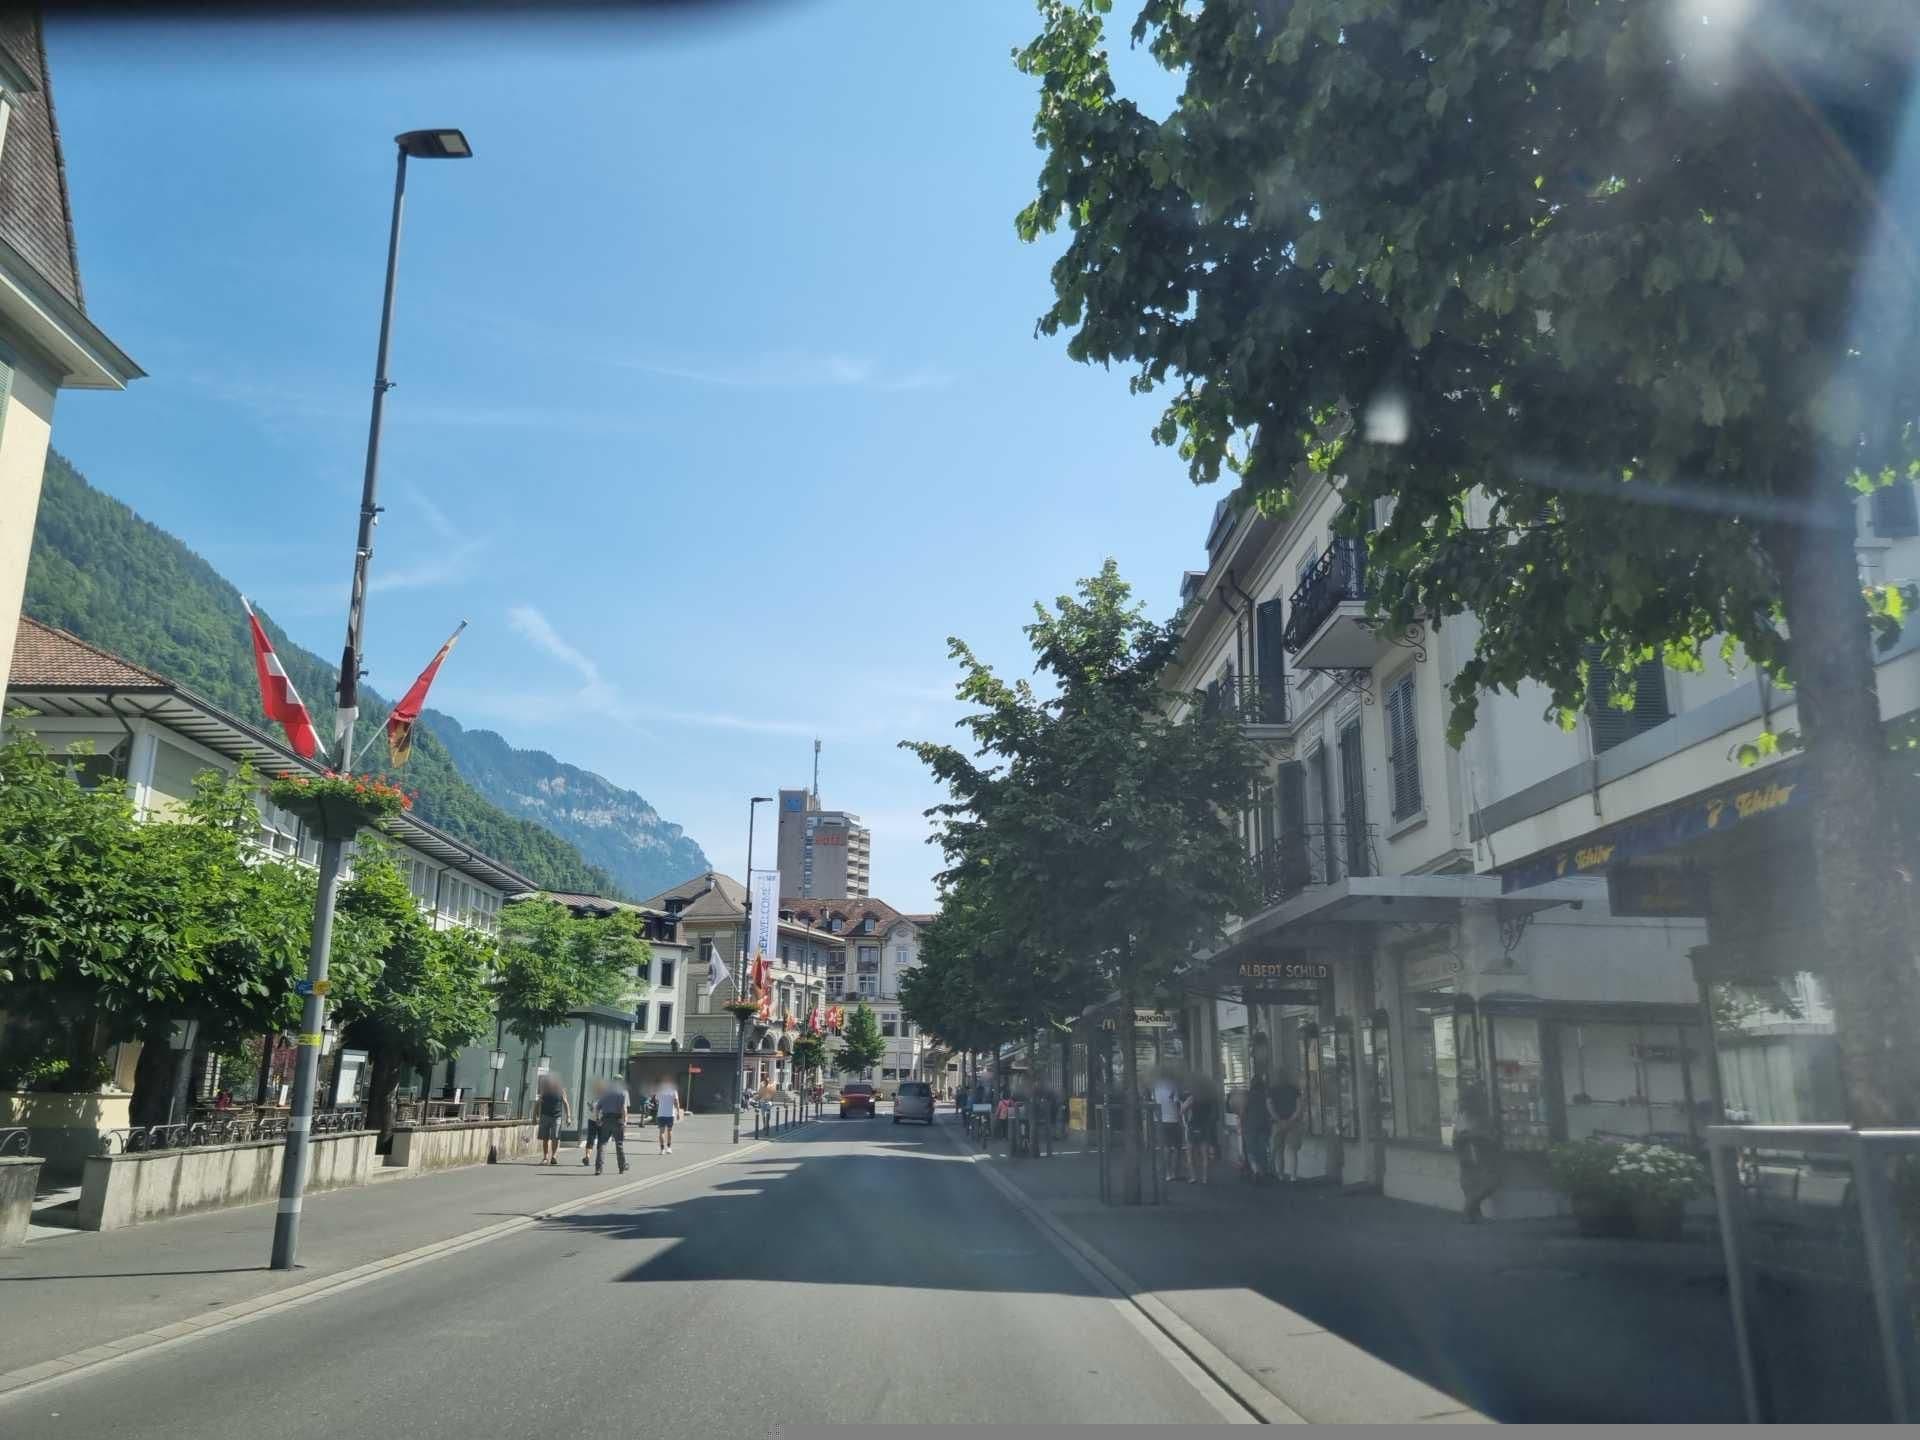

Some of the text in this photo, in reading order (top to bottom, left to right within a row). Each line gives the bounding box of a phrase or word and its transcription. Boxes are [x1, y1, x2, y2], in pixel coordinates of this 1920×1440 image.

[1735, 785, 1797, 816] Tchibo
[1239, 964, 1327, 977] ALBERT SCHILD
[1135, 1014, 1171, 1025] tagonia
